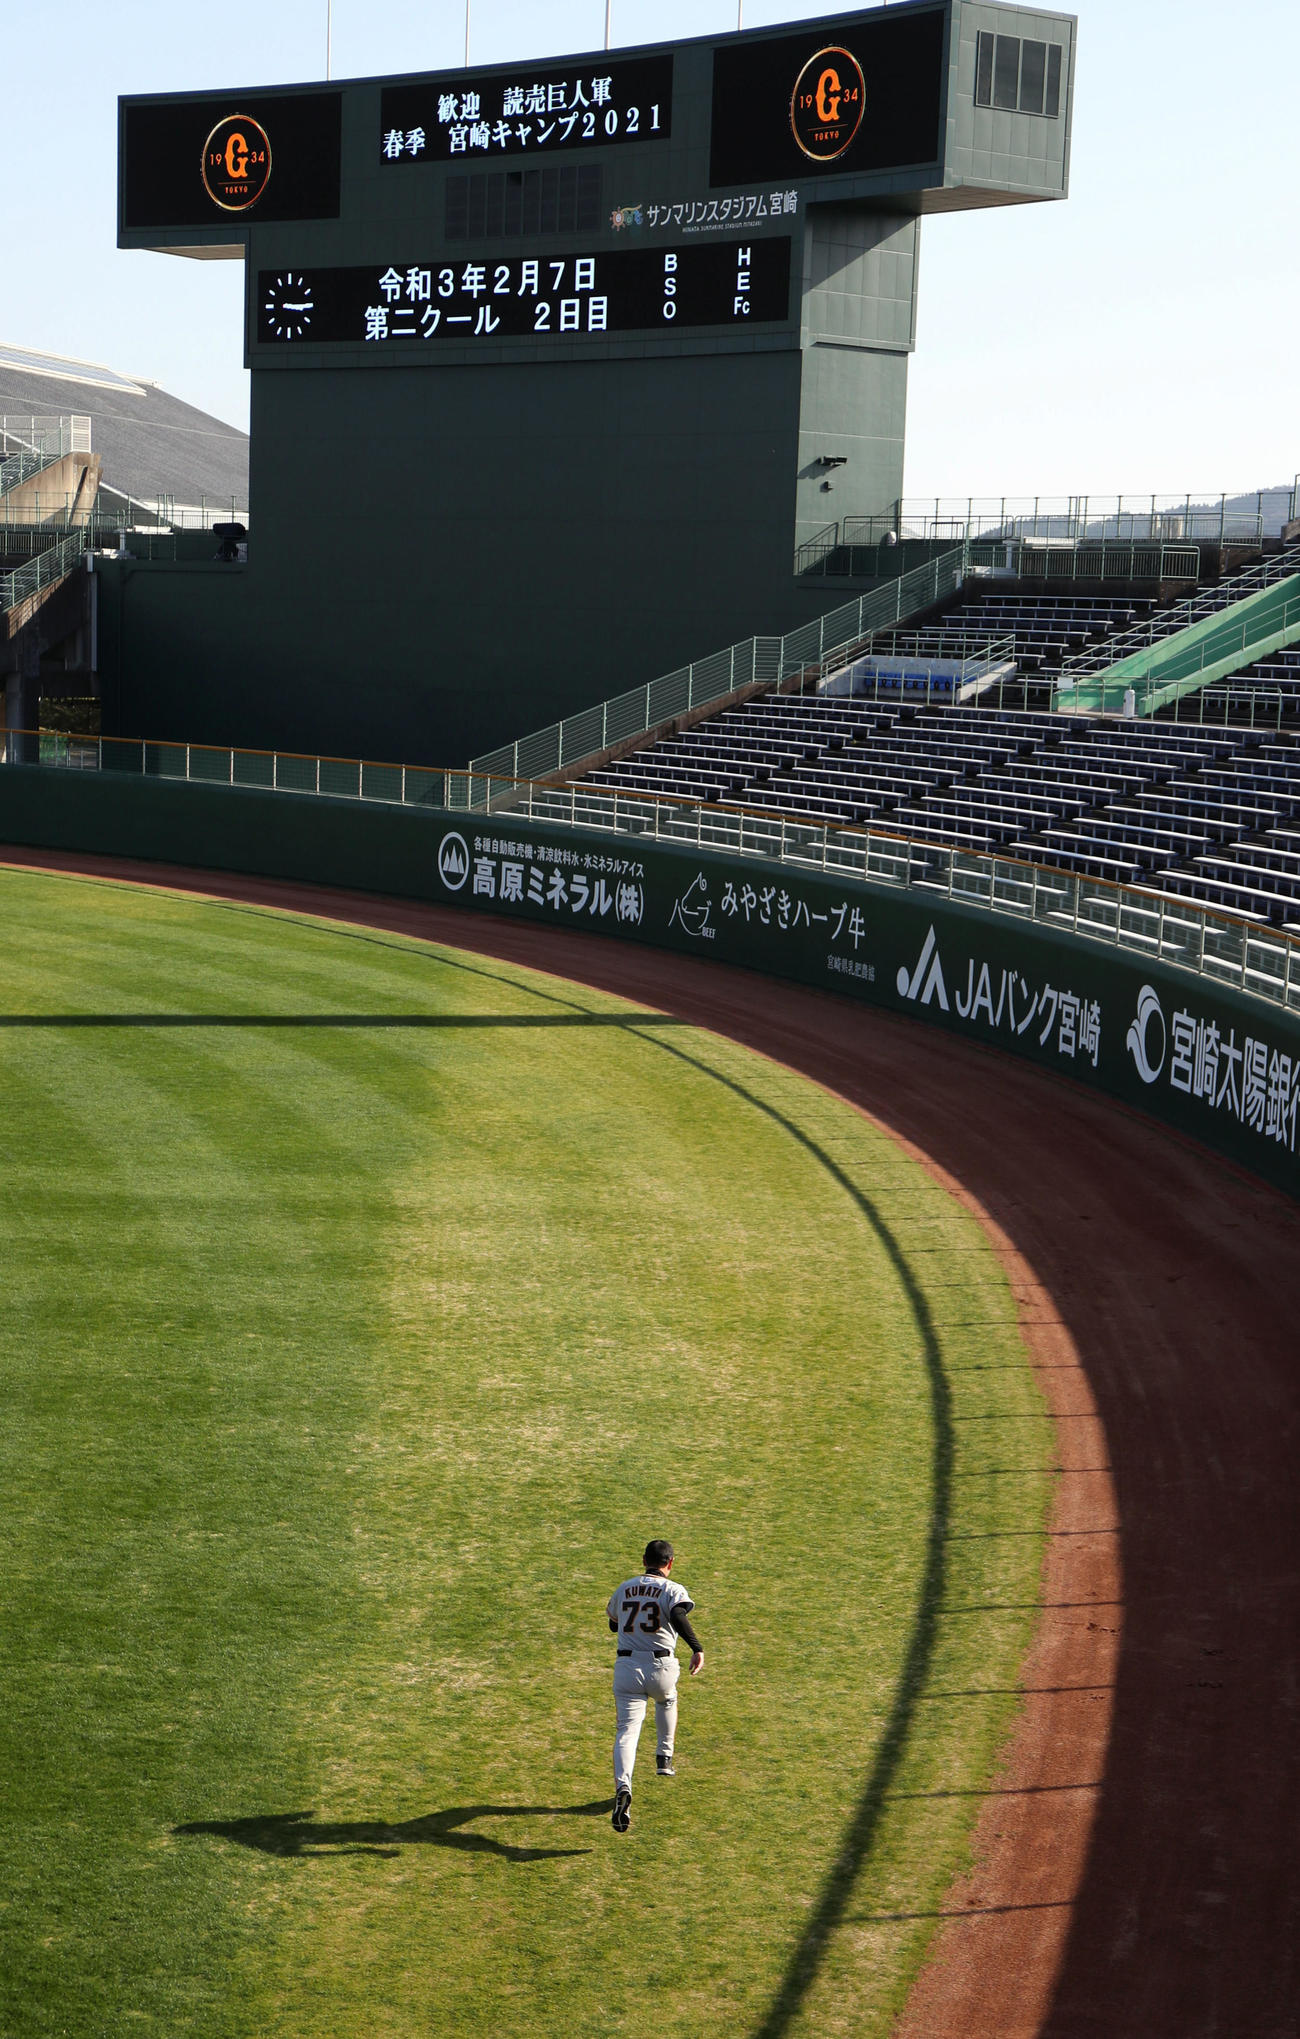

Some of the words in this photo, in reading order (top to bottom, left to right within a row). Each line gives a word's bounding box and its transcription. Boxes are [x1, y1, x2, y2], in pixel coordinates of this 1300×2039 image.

[437, 91, 481, 123] 歓迎
[502, 76, 613, 116] 読売巨人軍
[800, 95, 813, 109] 19
[815, 68, 842, 122] G
[843, 87, 858, 103] 34
[382, 126, 426, 158] 春季
[449, 104, 661, 153] 宮崎キャンプ2021
[814, 130, 839, 141] TOKYO
[210, 153, 222, 165] 19
[224, 132, 248, 178] G
[251, 151, 265, 163] 34
[225, 185, 248, 194] TOKYO
[647, 189, 798, 227] サンマリンスタジアム宮崎
[664, 253, 678, 272] B
[738, 247, 751, 266] H
[379, 258, 596, 302] 令和3年2月7日
[663, 277, 676, 296] S
[737, 271, 750, 290] E
[364, 304, 500, 340] 第二クール
[534, 296, 608, 332] 2日目
[663, 301, 676, 319] O
[733, 296, 750, 315] Fc
[472, 856, 644, 926] 高原ミネラル(株)
[721, 881, 865, 949] みやざきハーブ牛
[702, 926, 717, 939] BEEF
[955, 958, 1101, 1067] JAバンク宮崎
[625, 1585, 662, 1599] KUWATA
[622, 1601, 660, 1632] 73
